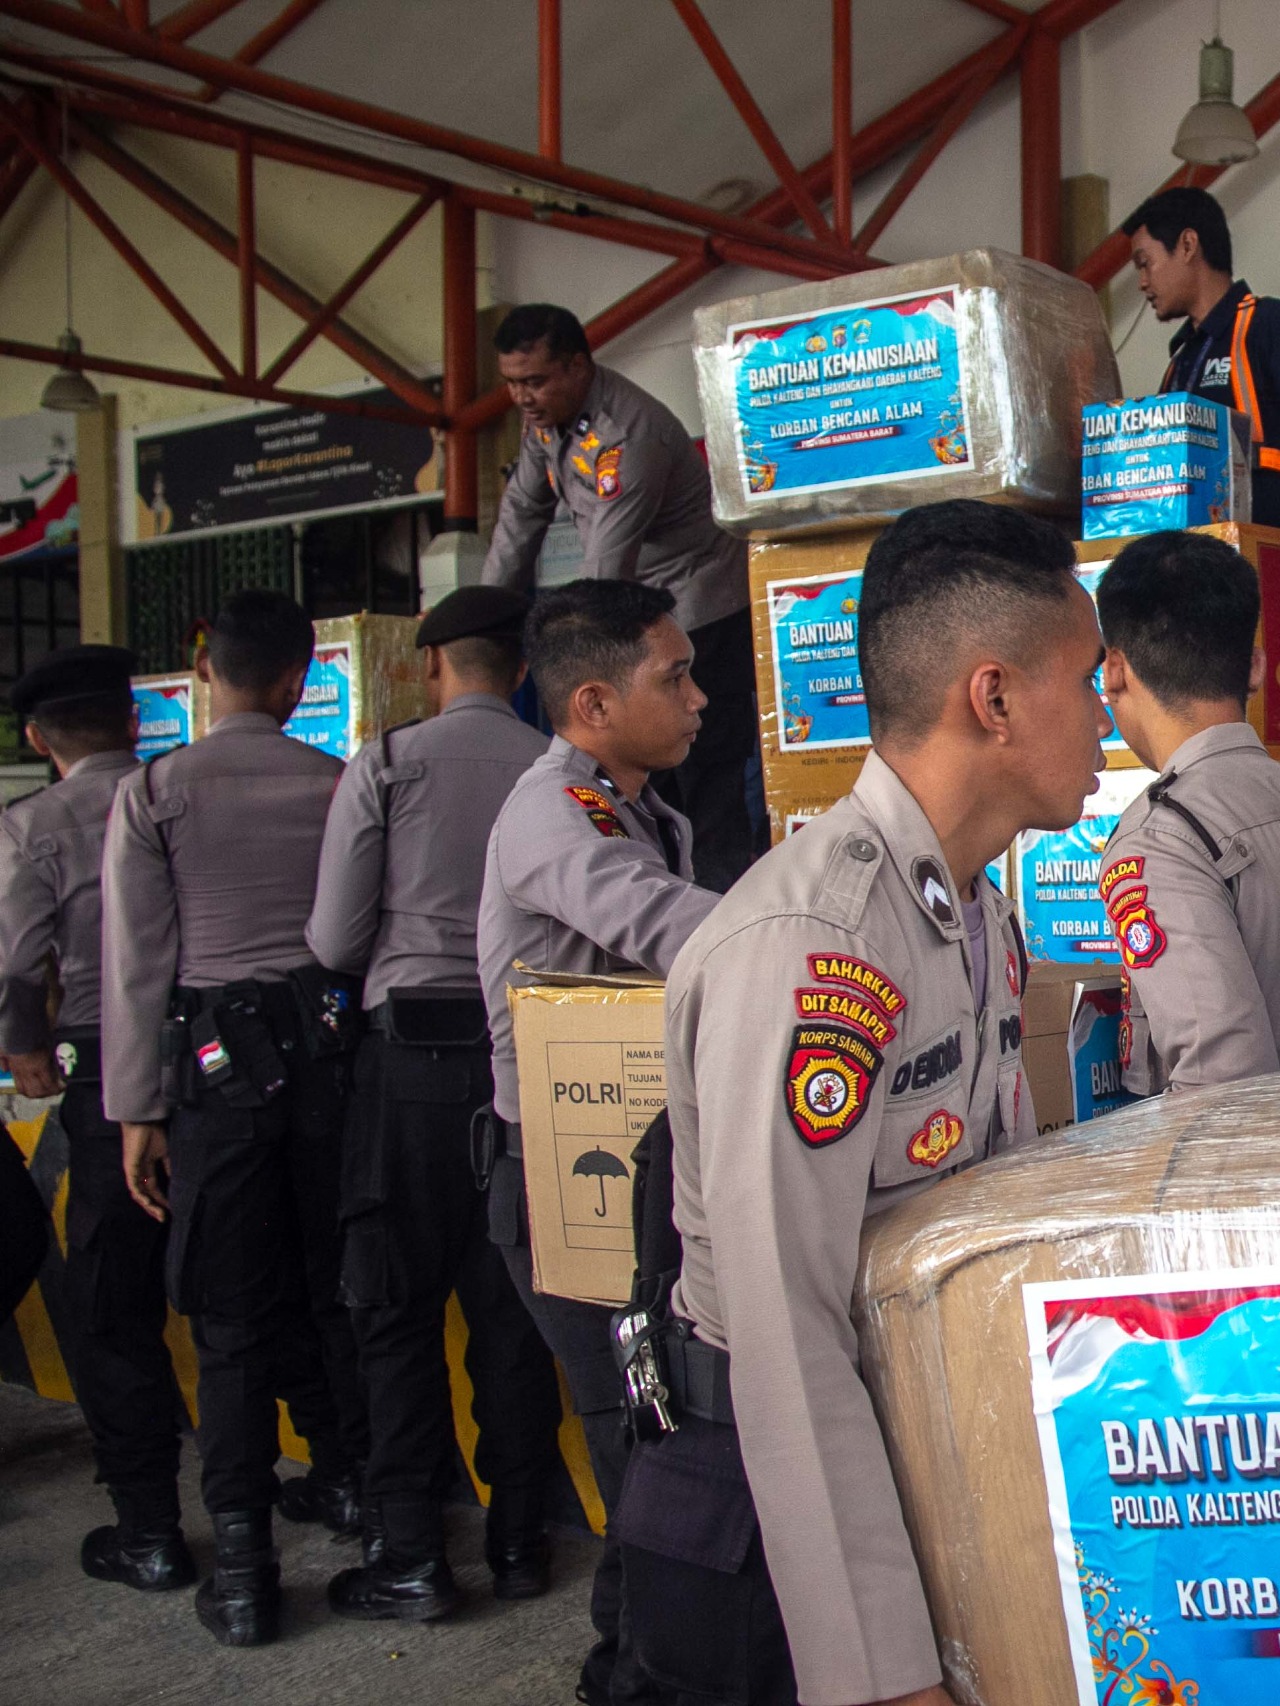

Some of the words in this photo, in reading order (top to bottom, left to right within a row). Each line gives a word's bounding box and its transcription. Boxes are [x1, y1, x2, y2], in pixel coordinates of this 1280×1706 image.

[749, 360, 819, 390] BANTUAN
[823, 338, 938, 378] KEMANUSIAAN
[774, 388, 804, 403] KALTENG
[805, 387, 821, 399] DAN
[822, 377, 874, 396] BHAYANGKARI
[875, 372, 906, 388] DAERAH
[907, 366, 942, 382] KALTENG
[830, 398, 853, 409] UNTUK
[770, 420, 818, 439] KORBAN
[821, 408, 880, 431] BENCANA
[885, 401, 923, 420] ALAM
[1121, 402, 1217, 431] KEMANUSIAAN
[869, 426, 895, 439] BARAT
[1125, 452, 1149, 465] UNTUK
[1116, 463, 1174, 487] BENCANA
[1178, 462, 1206, 480] ALAM
[790, 620, 854, 647] BANTUAN
[809, 675, 852, 693] KORBAN
[1035, 859, 1101, 883] BANTUAN
[1101, 861, 1138, 895] POLDA
[1035, 889, 1056, 901] POLDA
[1058, 888, 1087, 900] KALTENG
[1052, 920, 1099, 936] KORBAN
[1081, 941, 1111, 950] PROVINSI
[816, 959, 900, 1011] BAHARKAM
[626, 1051, 651, 1059] NAMA
[799, 1031, 838, 1045] KORPS
[838, 1035, 876, 1069] SABHARA
[627, 1074, 662, 1082] TUJUAN
[554, 1082, 622, 1104] POLRI
[629, 1098, 641, 1106] NO
[644, 1098, 668, 1107] KODE
[1111, 1496, 1179, 1524] POLDA
